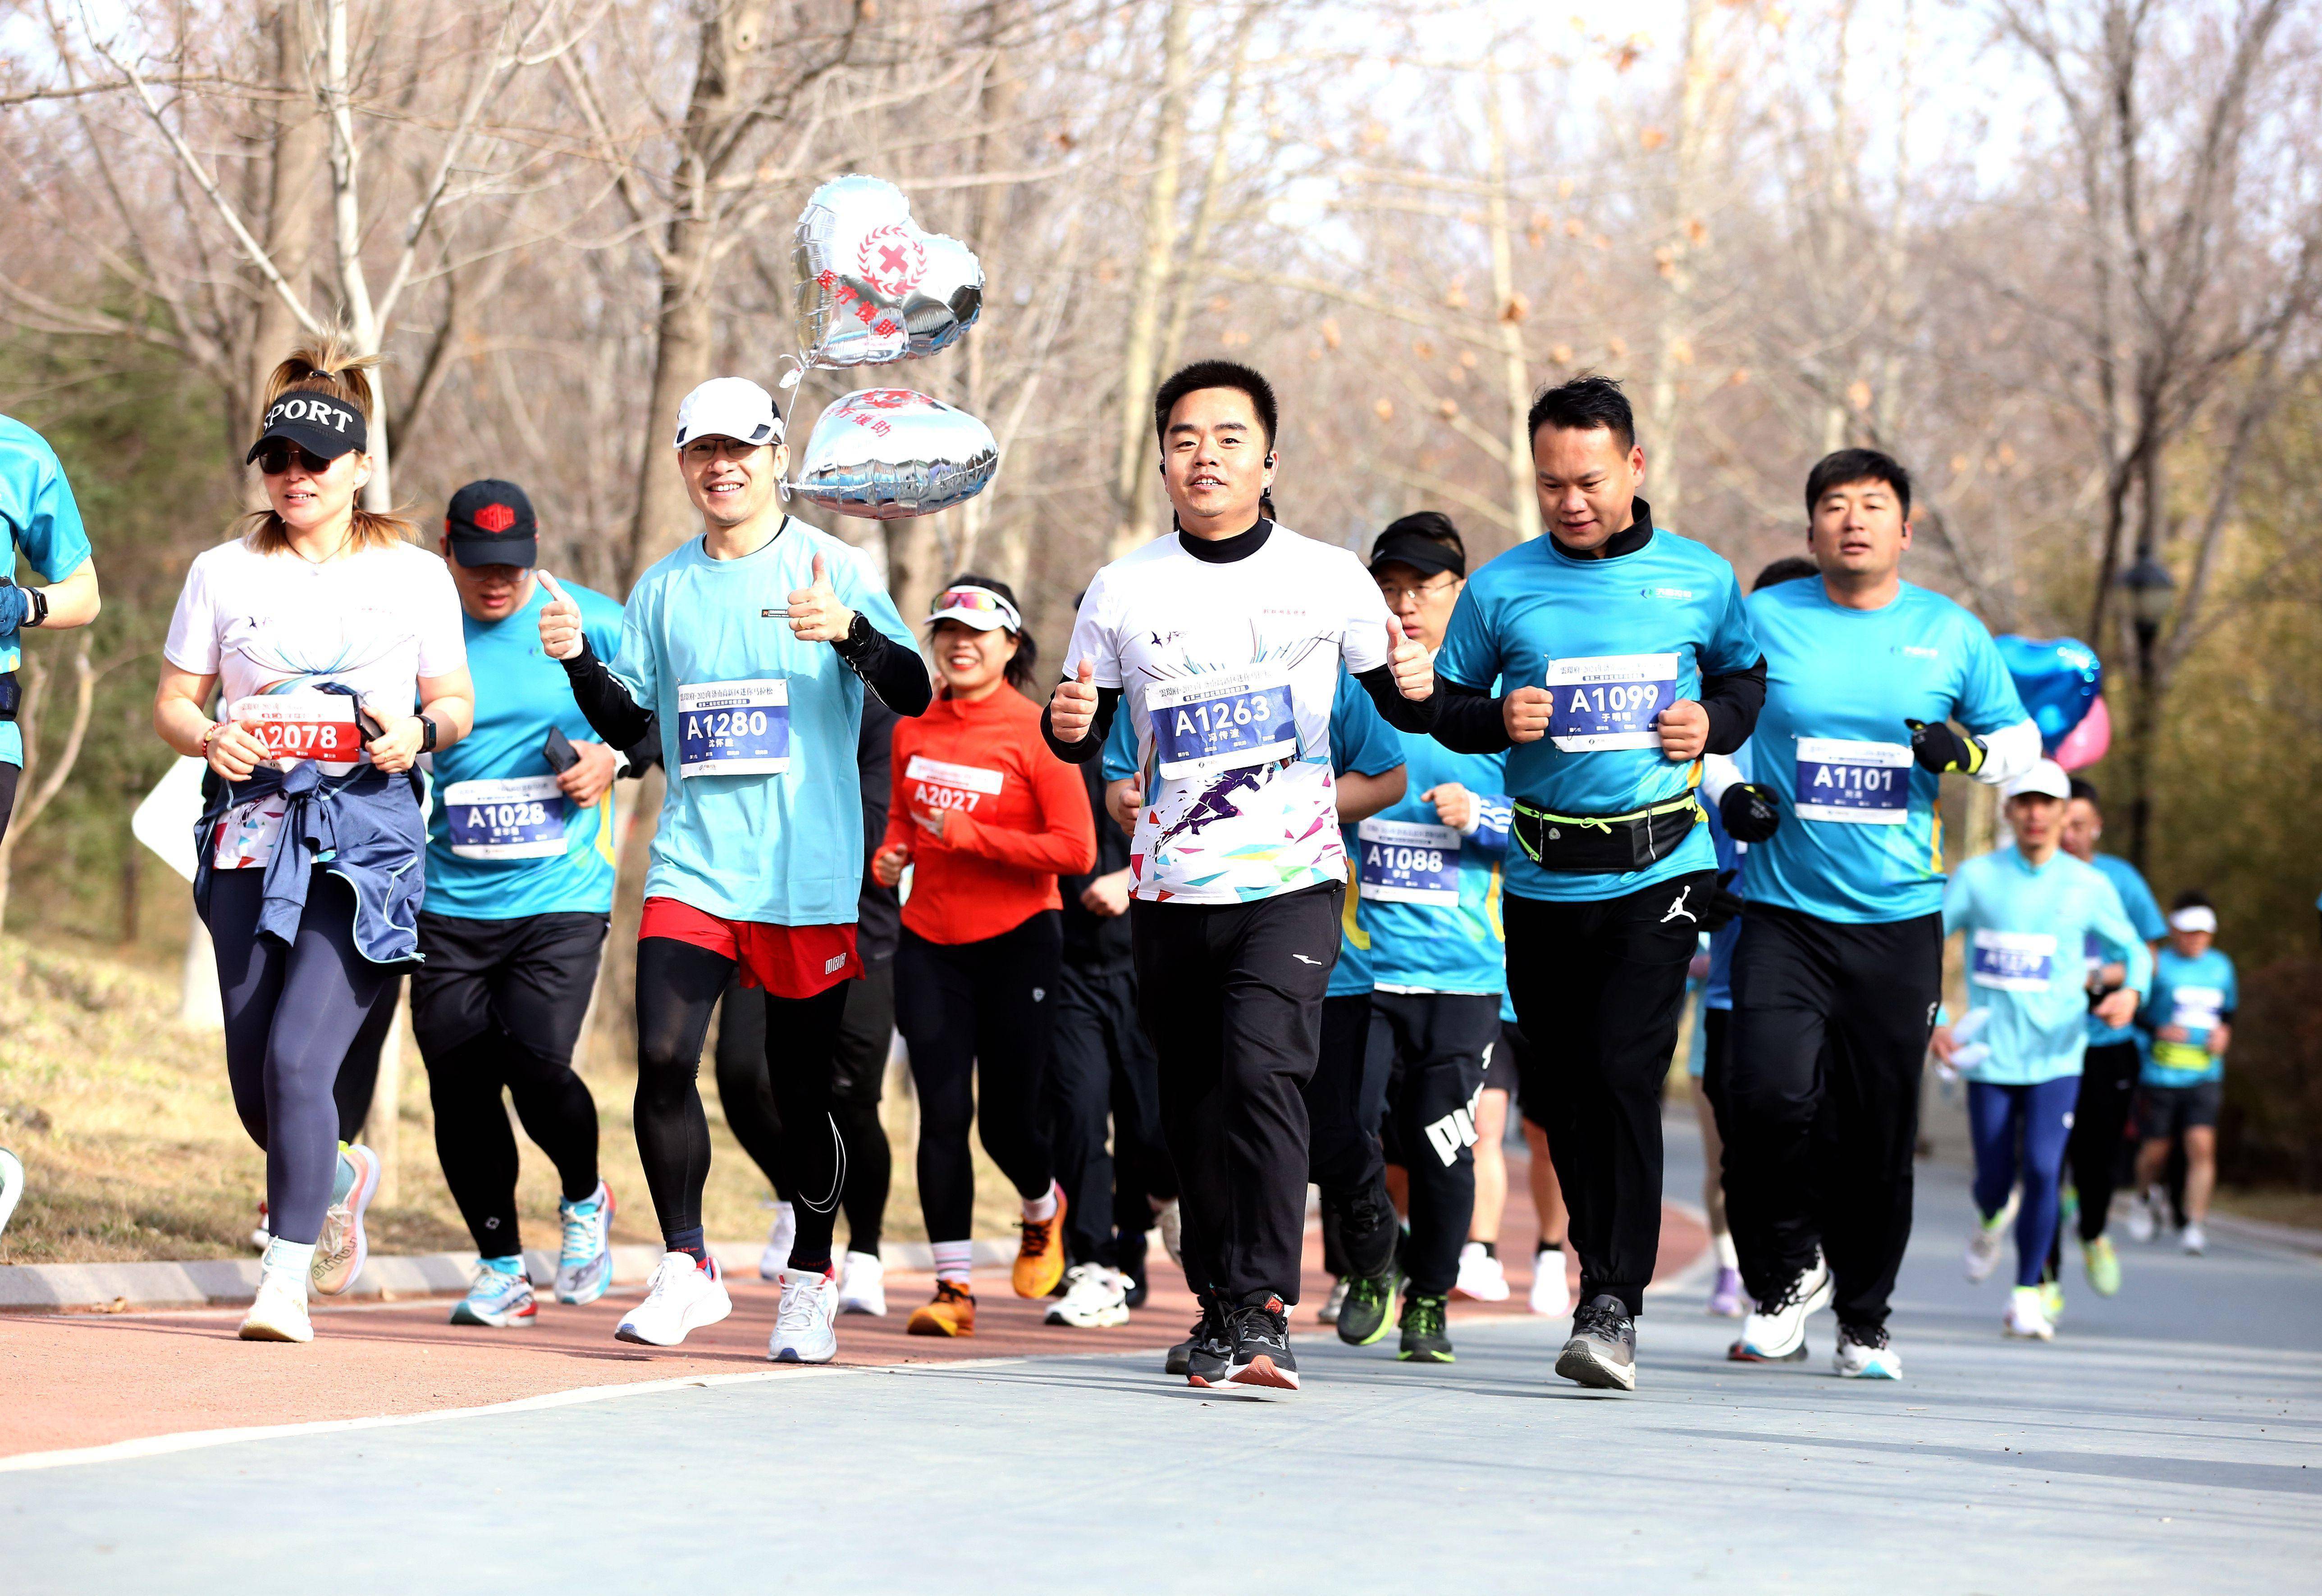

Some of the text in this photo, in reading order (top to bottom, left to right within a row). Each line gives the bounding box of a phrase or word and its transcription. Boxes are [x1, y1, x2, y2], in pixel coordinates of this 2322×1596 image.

[1569, 684, 1659, 713] A1099
[687, 711, 768, 740] A1280
[1175, 695, 1271, 737] A1263
[253, 725, 338, 749] A2078
[1813, 765, 1893, 792] A1101
[914, 783, 981, 813] A2027
[466, 802, 547, 828] A1028
[1367, 844, 1444, 873] A1088
[825, 952, 846, 975] URG
